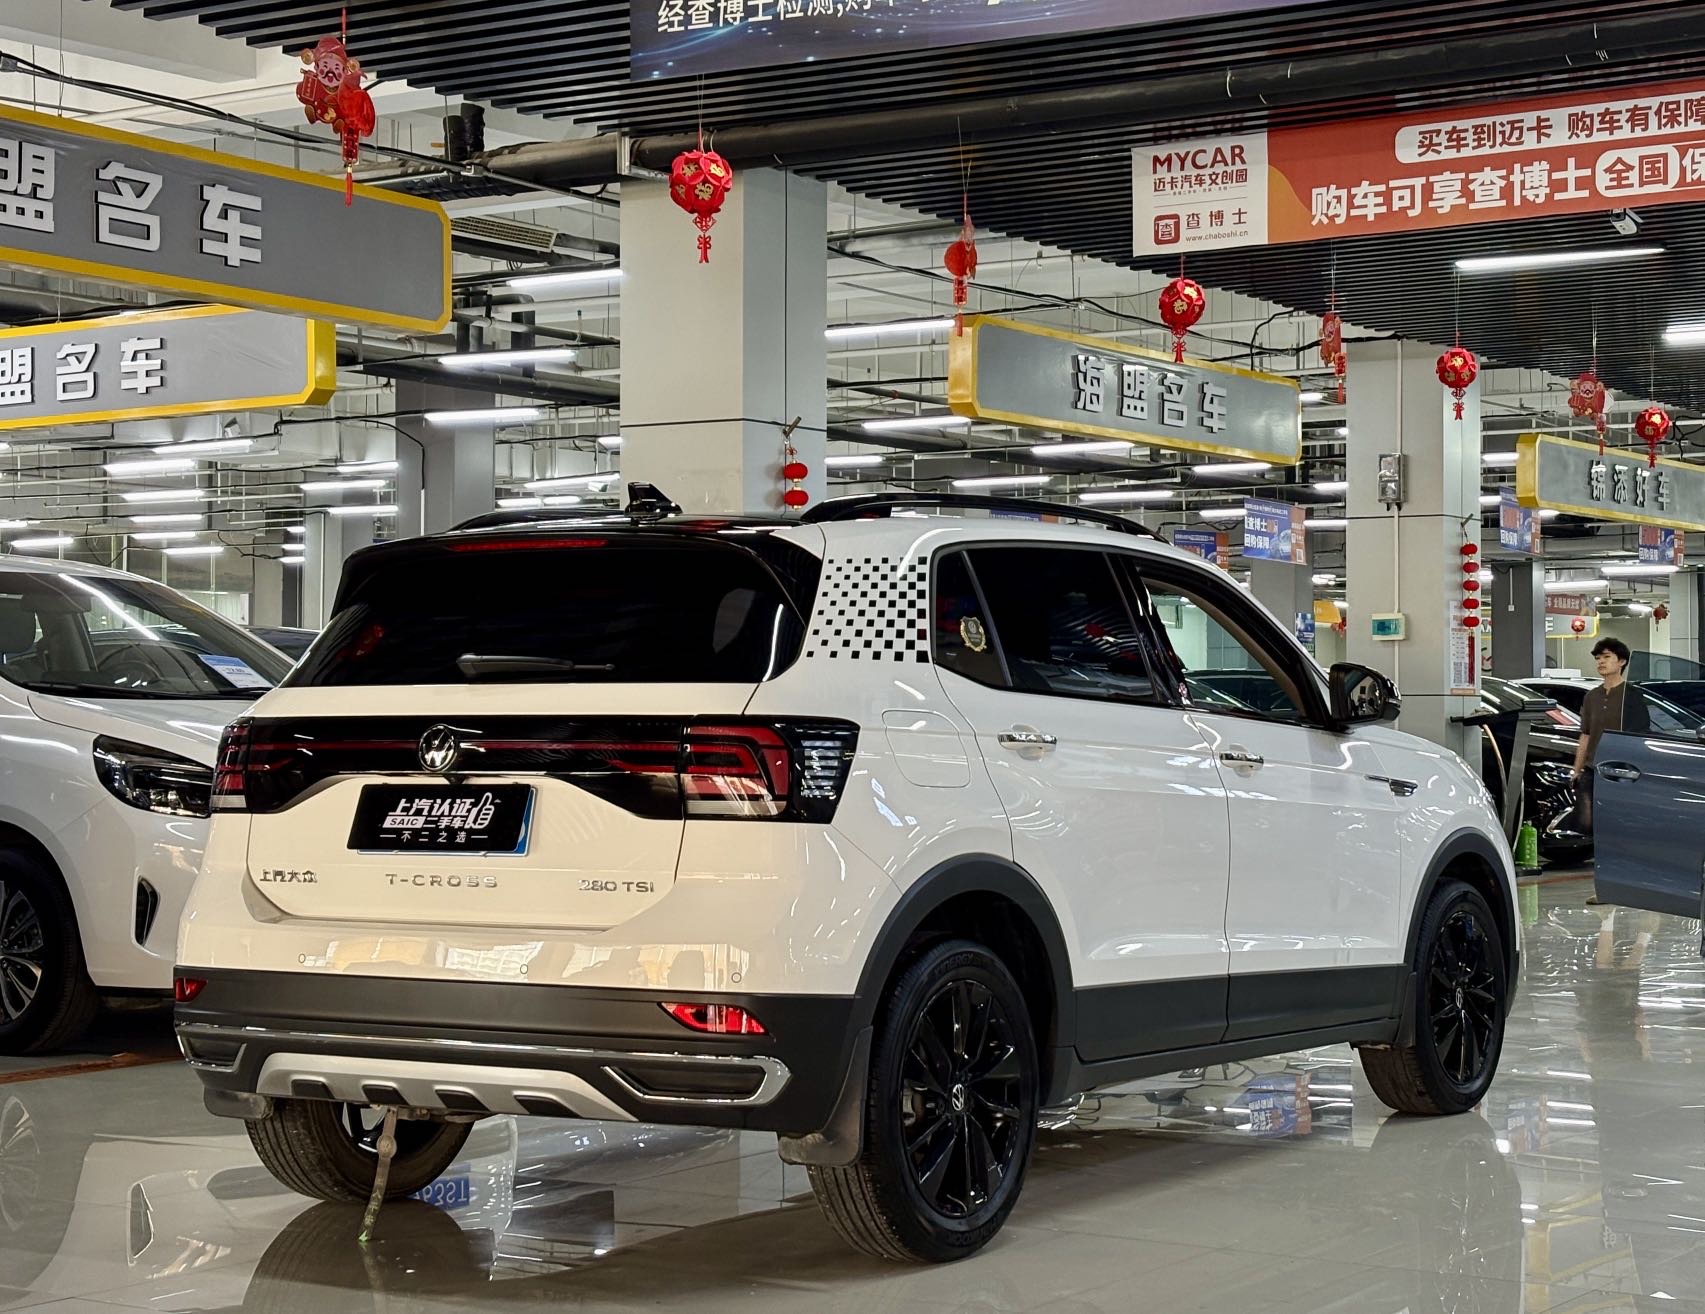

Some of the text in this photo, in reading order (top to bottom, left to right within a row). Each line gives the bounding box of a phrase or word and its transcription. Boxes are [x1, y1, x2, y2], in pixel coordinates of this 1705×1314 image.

[1417, 98, 1705, 157] 买车到迈卡 购车有保障
[1152, 144, 1247, 175] MYCAR
[1153, 168, 1248, 193] 迈卡汽车文创园
[0, 138, 263, 268] 盟名车
[1186, 208, 1248, 230] 查博士
[1186, 230, 1249, 242] www.chaboshi.cn
[0, 337, 165, 405] 盟名车
[1074, 355, 1227, 433] 海盟名车
[388, 798, 476, 816] 上汽认证
[389, 816, 467, 829] SAIC 二手车
[401, 831, 467, 843] 不二之选
[259, 869, 318, 883] 上汽大众
[385, 873, 498, 888] T-CROSS
[578, 879, 655, 893] 280 TSI
